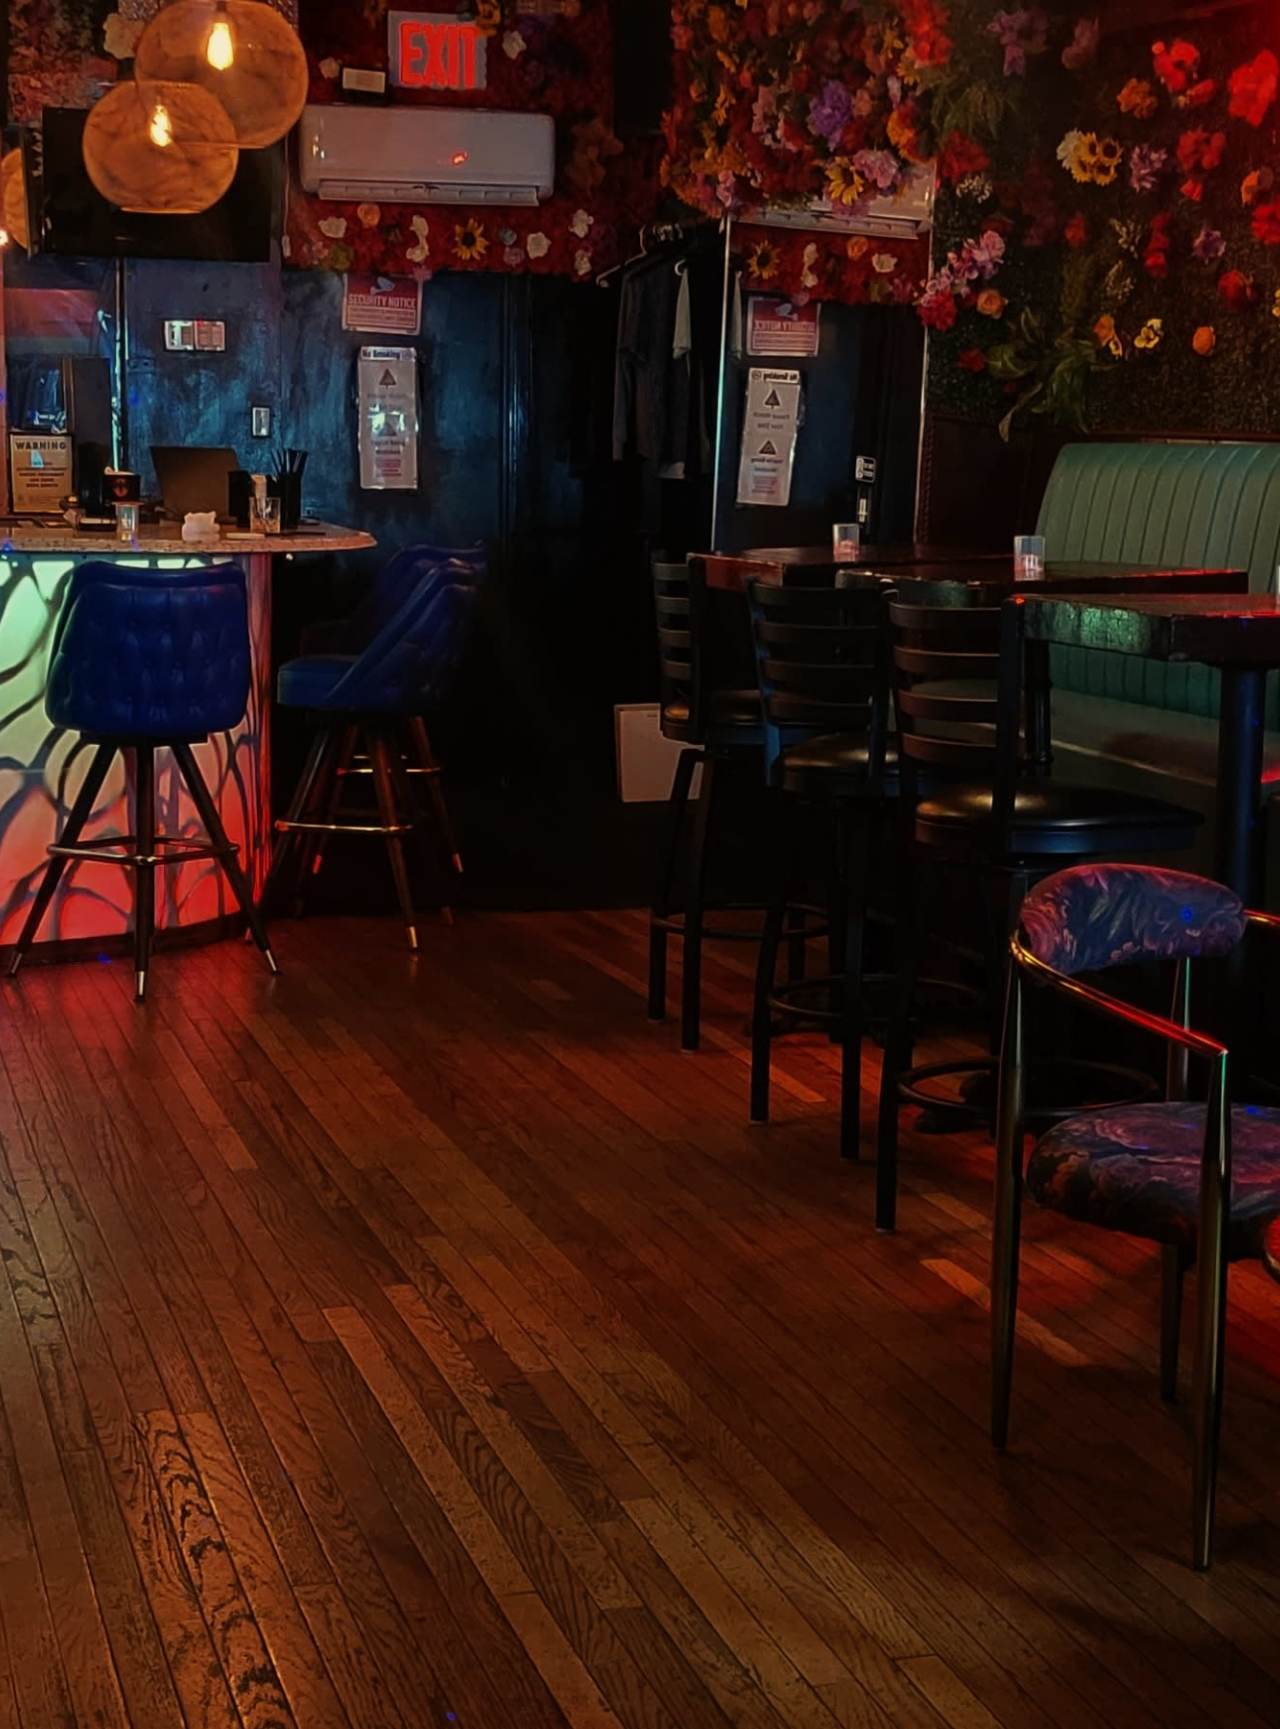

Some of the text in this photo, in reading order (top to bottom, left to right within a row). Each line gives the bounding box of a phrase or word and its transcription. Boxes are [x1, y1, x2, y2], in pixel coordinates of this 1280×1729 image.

[400, 21, 479, 87] EXIT
[348, 294, 417, 308] SECURITY NOTICE
[15, 441, 66, 450] WARNING
